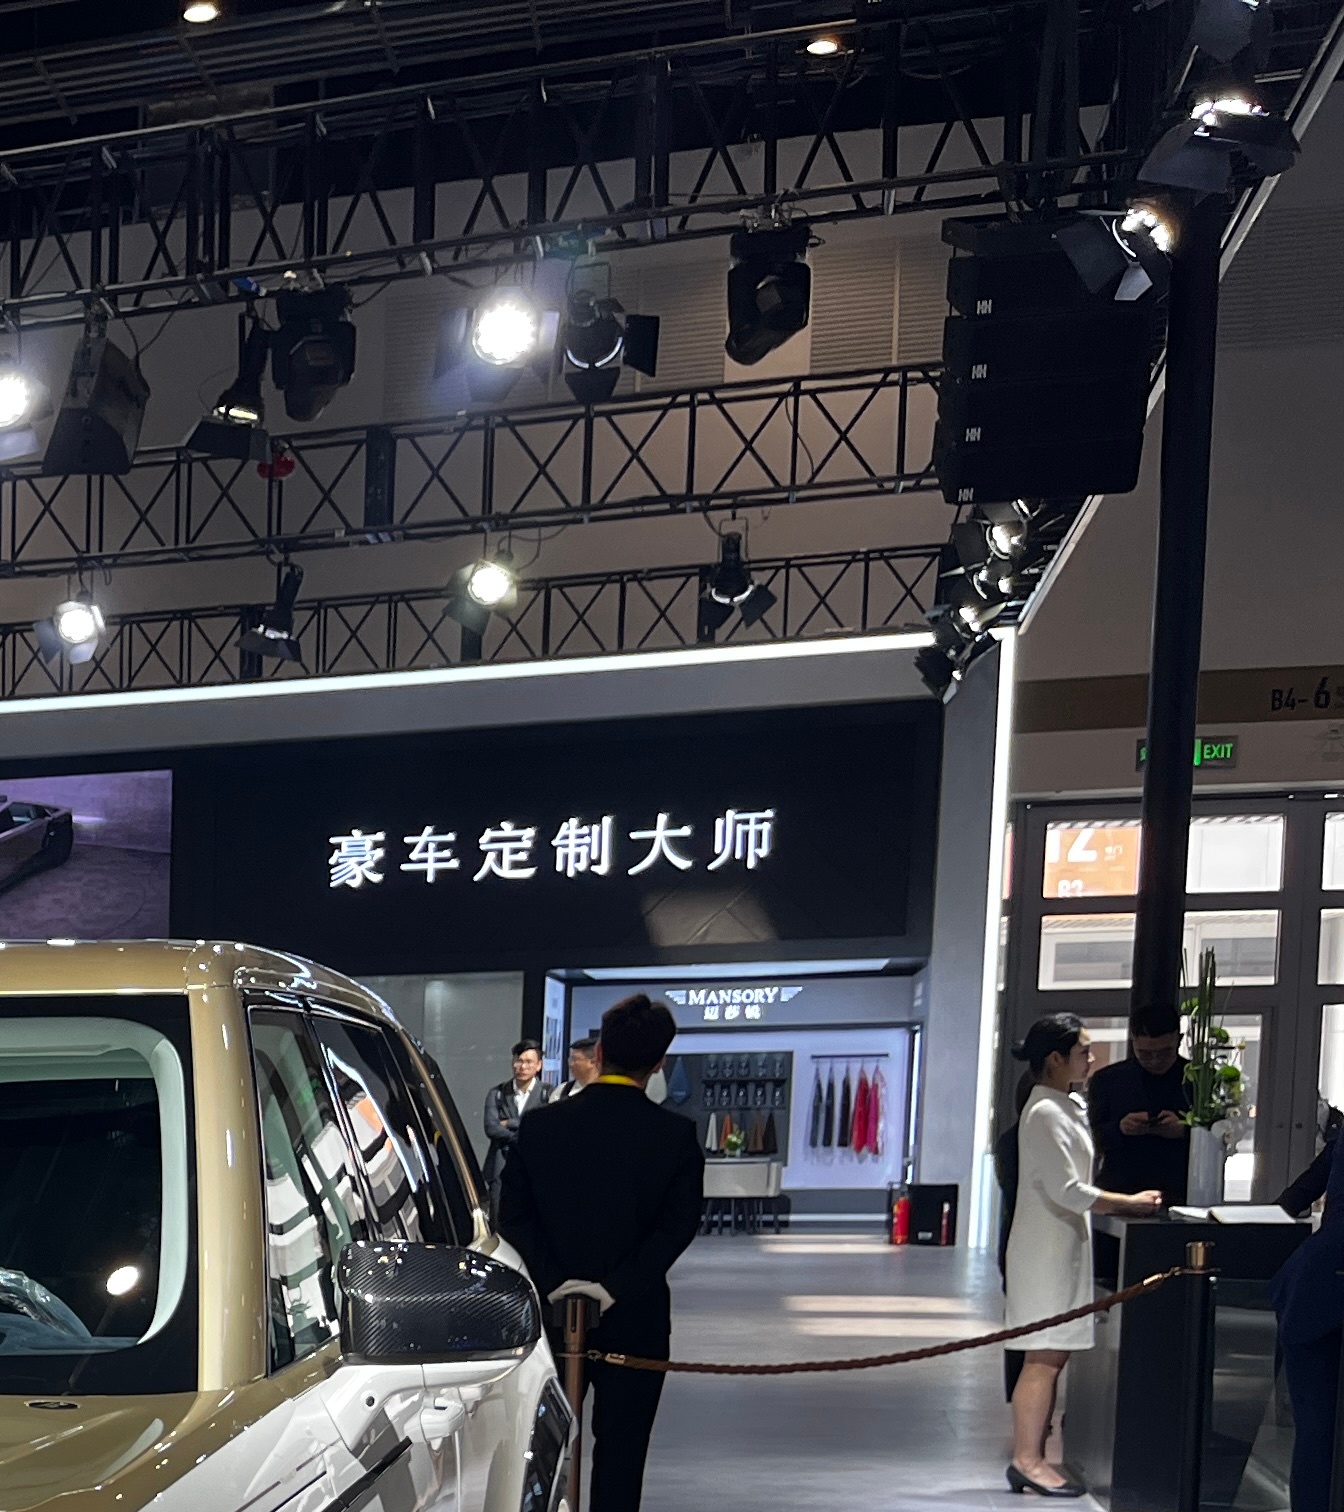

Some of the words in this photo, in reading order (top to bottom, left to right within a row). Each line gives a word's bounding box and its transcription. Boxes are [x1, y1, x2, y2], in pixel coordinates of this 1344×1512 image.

[1202, 743, 1233, 759] EXIT
[328, 808, 776, 889] 豪车定制大师
[688, 987, 779, 1005] MANSORY
